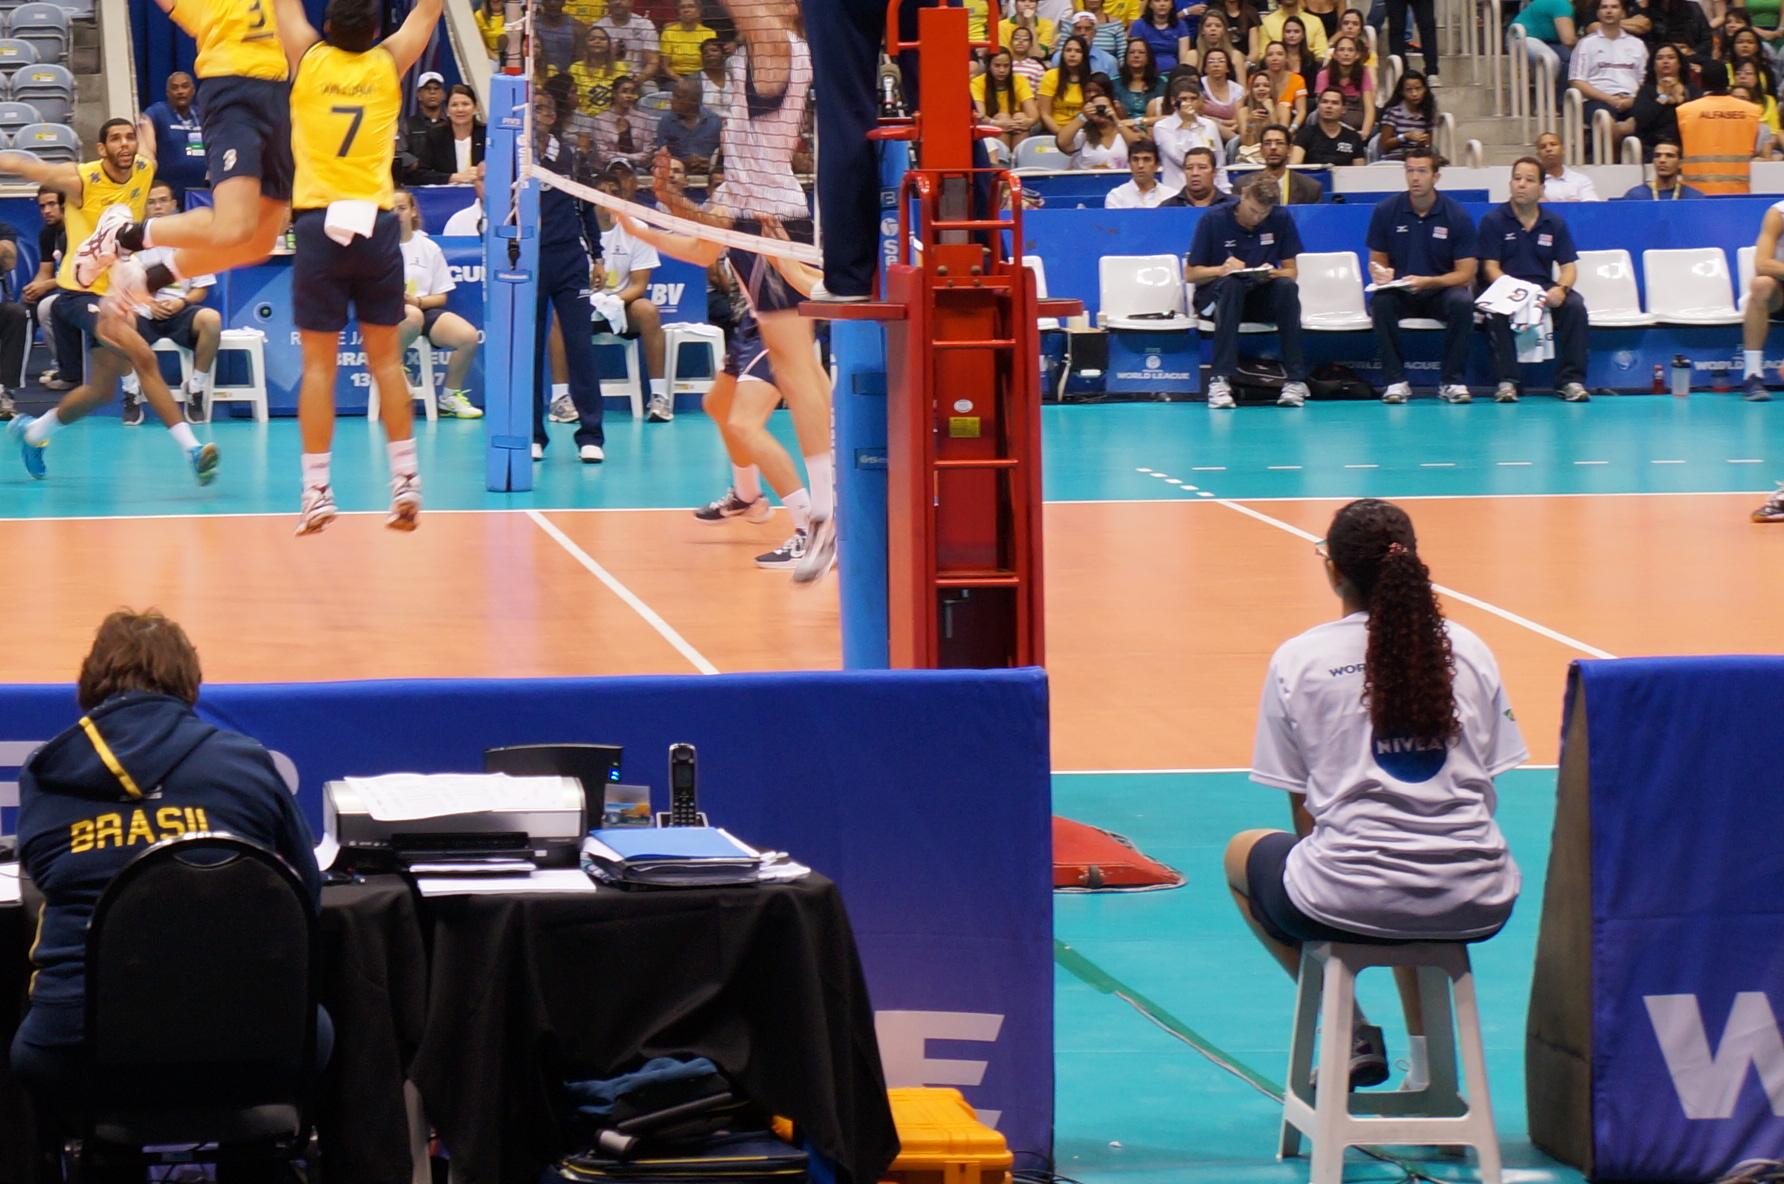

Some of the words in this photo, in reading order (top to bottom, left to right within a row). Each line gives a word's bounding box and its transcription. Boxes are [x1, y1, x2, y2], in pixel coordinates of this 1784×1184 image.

[331, 105, 365, 158] 7
[431, 352, 451, 365] EU
[1403, 361, 1442, 370] AGUE
[351, 373, 370, 387] 13
[1117, 371, 1154, 380] WORLD
[1155, 371, 1191, 380] LEAGUE
[1329, 663, 1365, 677] WOR
